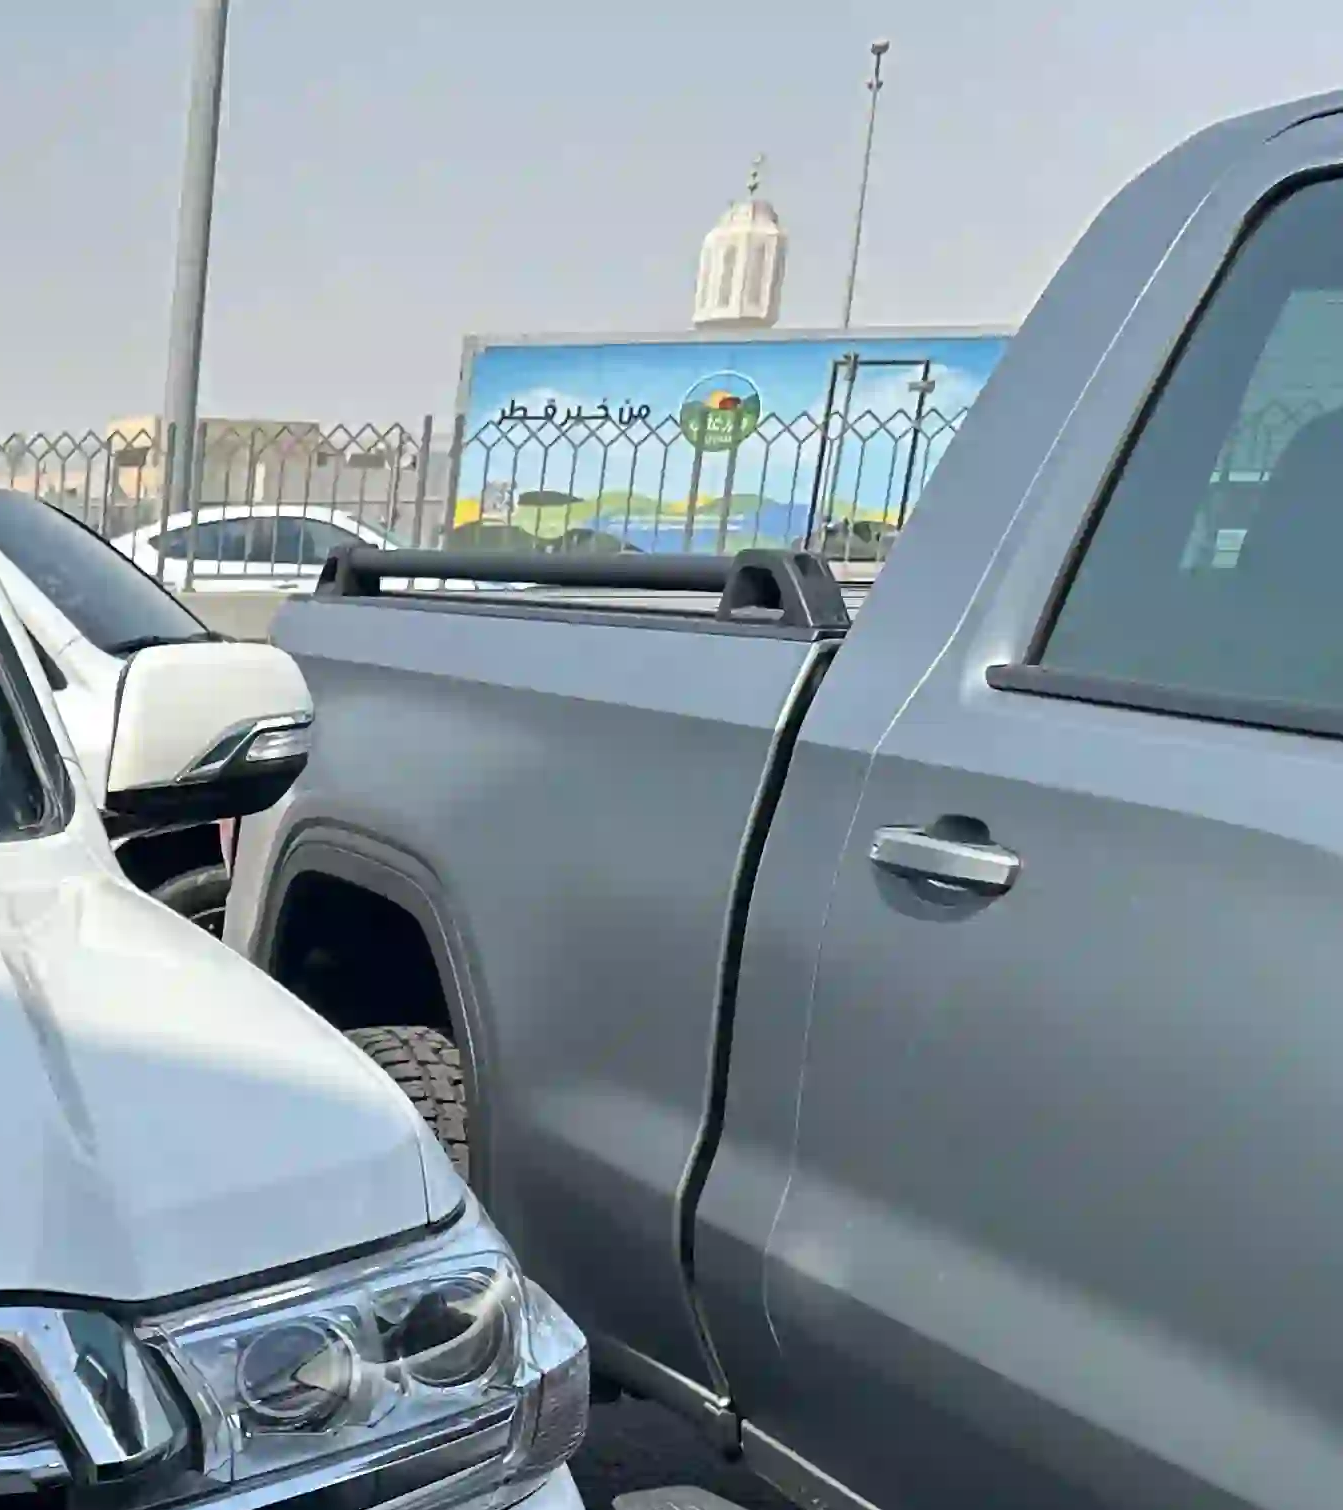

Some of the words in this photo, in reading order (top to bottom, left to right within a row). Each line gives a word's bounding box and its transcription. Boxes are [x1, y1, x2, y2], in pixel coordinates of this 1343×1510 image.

[497, 397, 557, 426] قطر
[559, 397, 610, 427] خير
[618, 398, 650, 425] من
